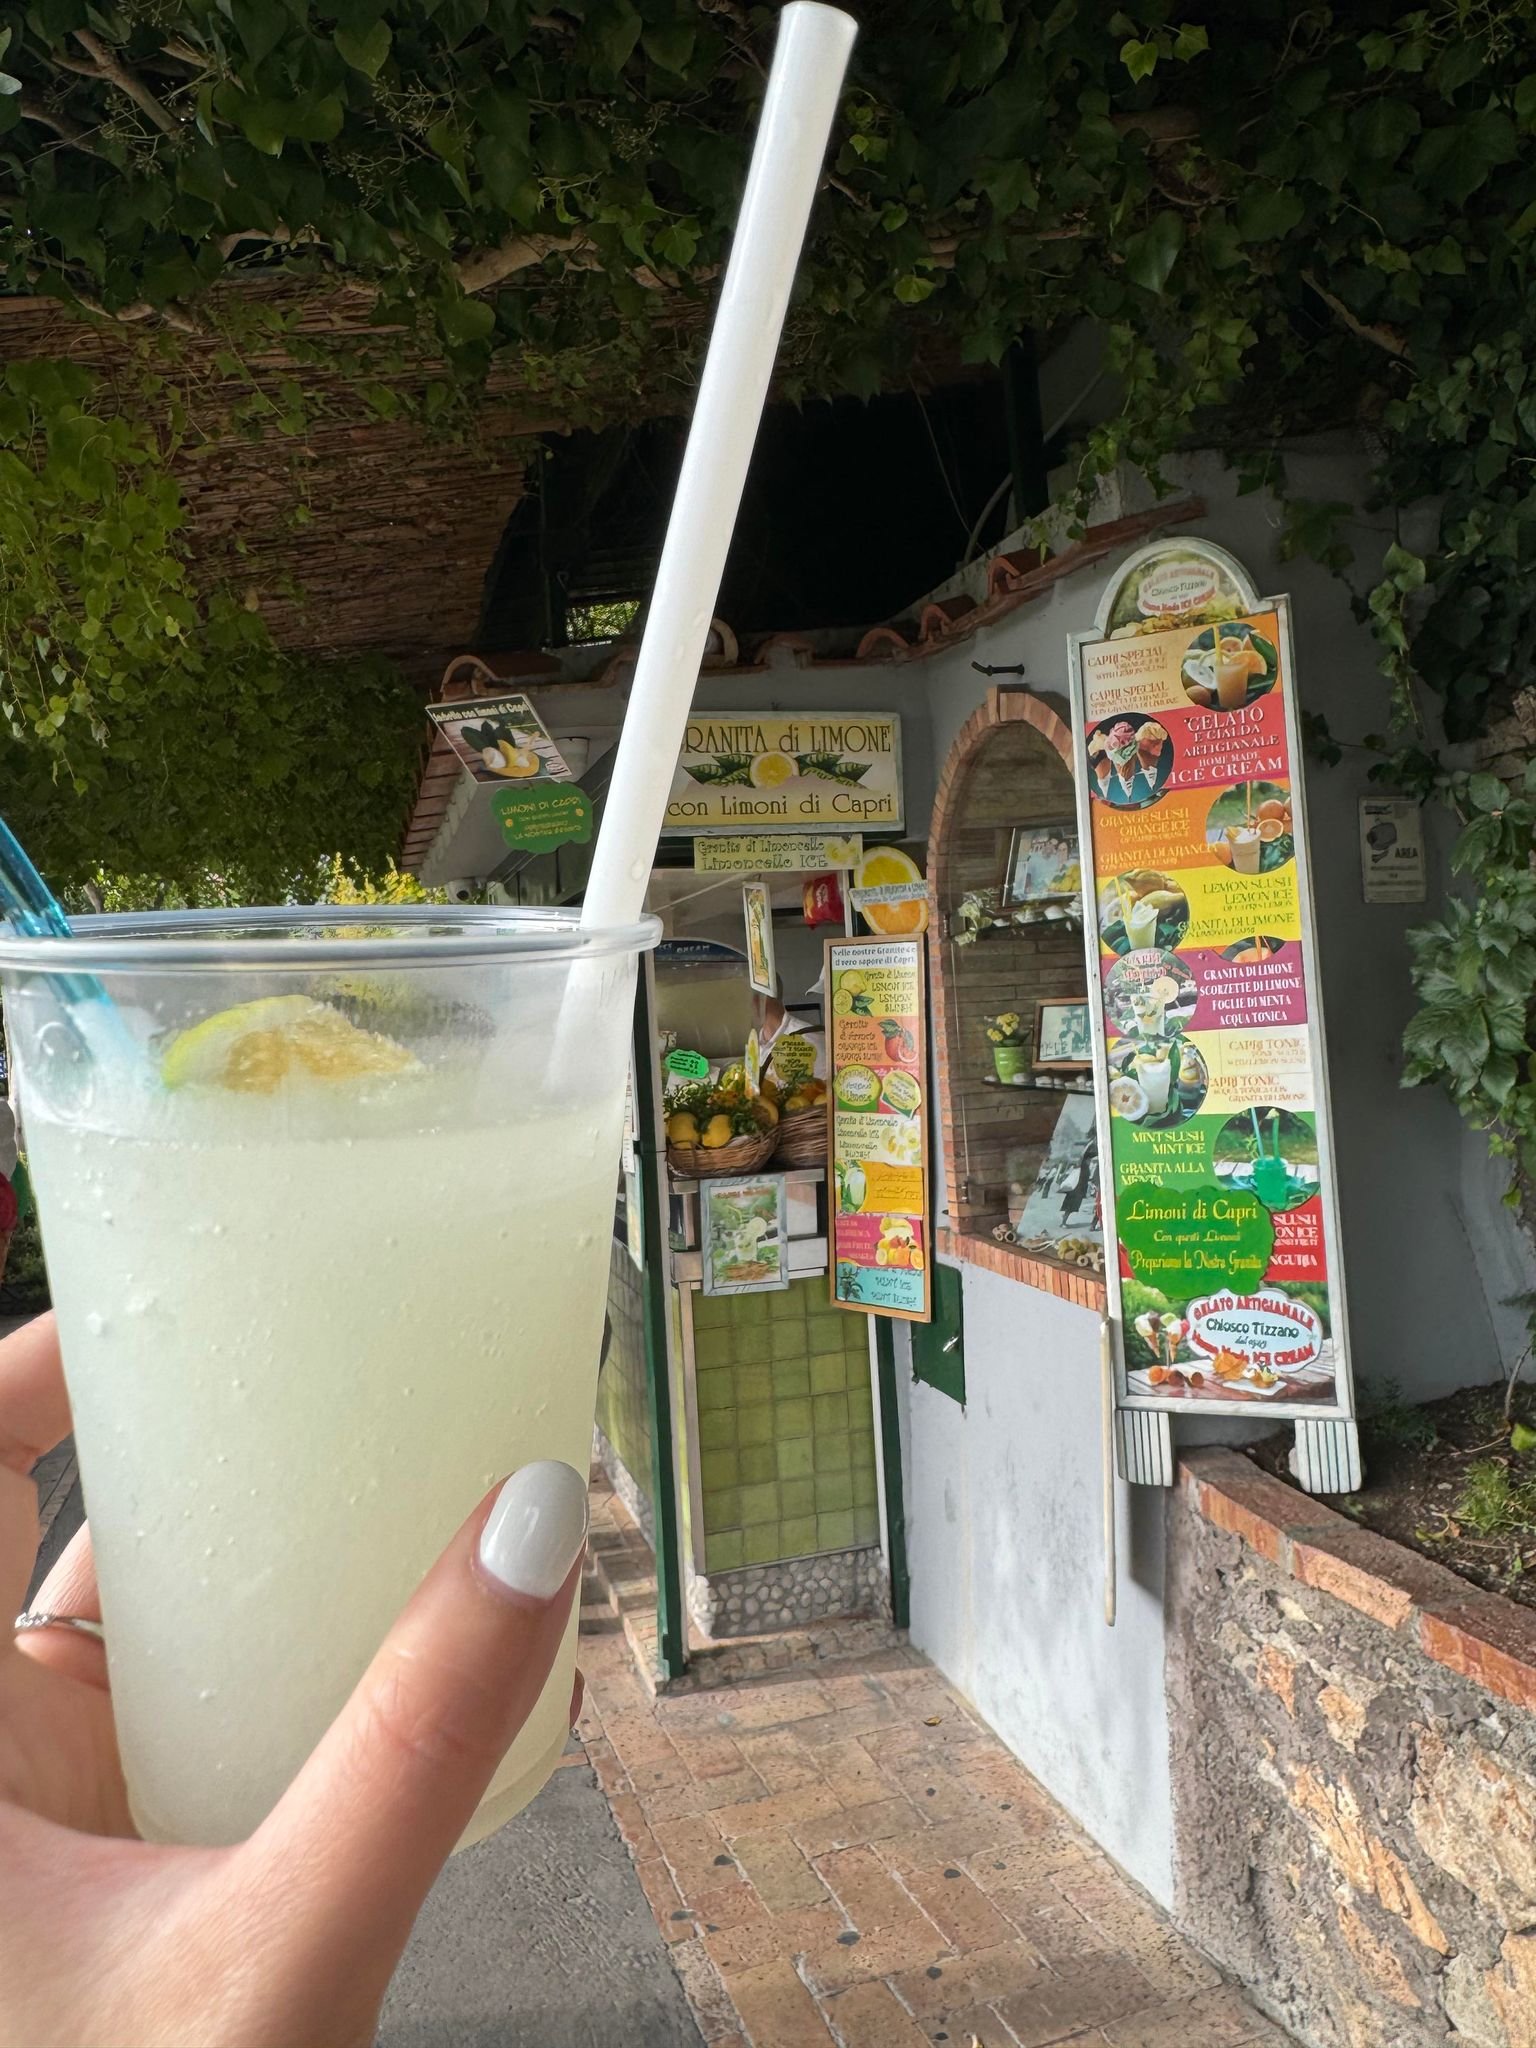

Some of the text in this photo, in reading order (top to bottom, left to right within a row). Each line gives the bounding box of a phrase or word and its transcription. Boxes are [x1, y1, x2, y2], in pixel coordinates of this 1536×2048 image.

[1187, 706, 1264, 733] GELATO
[683, 724, 891, 755] RANITA di LIMONE
[1194, 724, 1260, 742] E CIALDA
[1183, 733, 1279, 757] ARTIGIANALE
[1199, 752, 1259, 767] HOME MADE
[1171, 757, 1282, 784] ICE CREAM
[667, 792, 893, 820] con Limoni di Capri
[801, 855, 828, 870] ICE
[1203, 880, 1249, 894] LEMON
[1224, 892, 1270, 905] LEMON
[1203, 962, 1294, 981] GRANITA DI LIMONE
[1199, 977, 1302, 997] SCORZETTE DI LIMONE
[1211, 994, 1292, 1011] FOGLIE DI MENTA
[1219, 1010, 1288, 1027] ACQUA TONICA
[1229, 1040, 1264, 1051] CAPRI
[1132, 1131, 1204, 1143] MINT SLUSH
[1152, 1143, 1206, 1154] MINT ICE
[1120, 1162, 1204, 1175] GRANITA ALLA
[1126, 1199, 1258, 1227] Limoni di Capri
[1153, 1230, 1172, 1242] Con
[1194, 1296, 1314, 1332] GELATO ARTIGIANALE
[1206, 1318, 1300, 1338] Chiosco Tizzano
